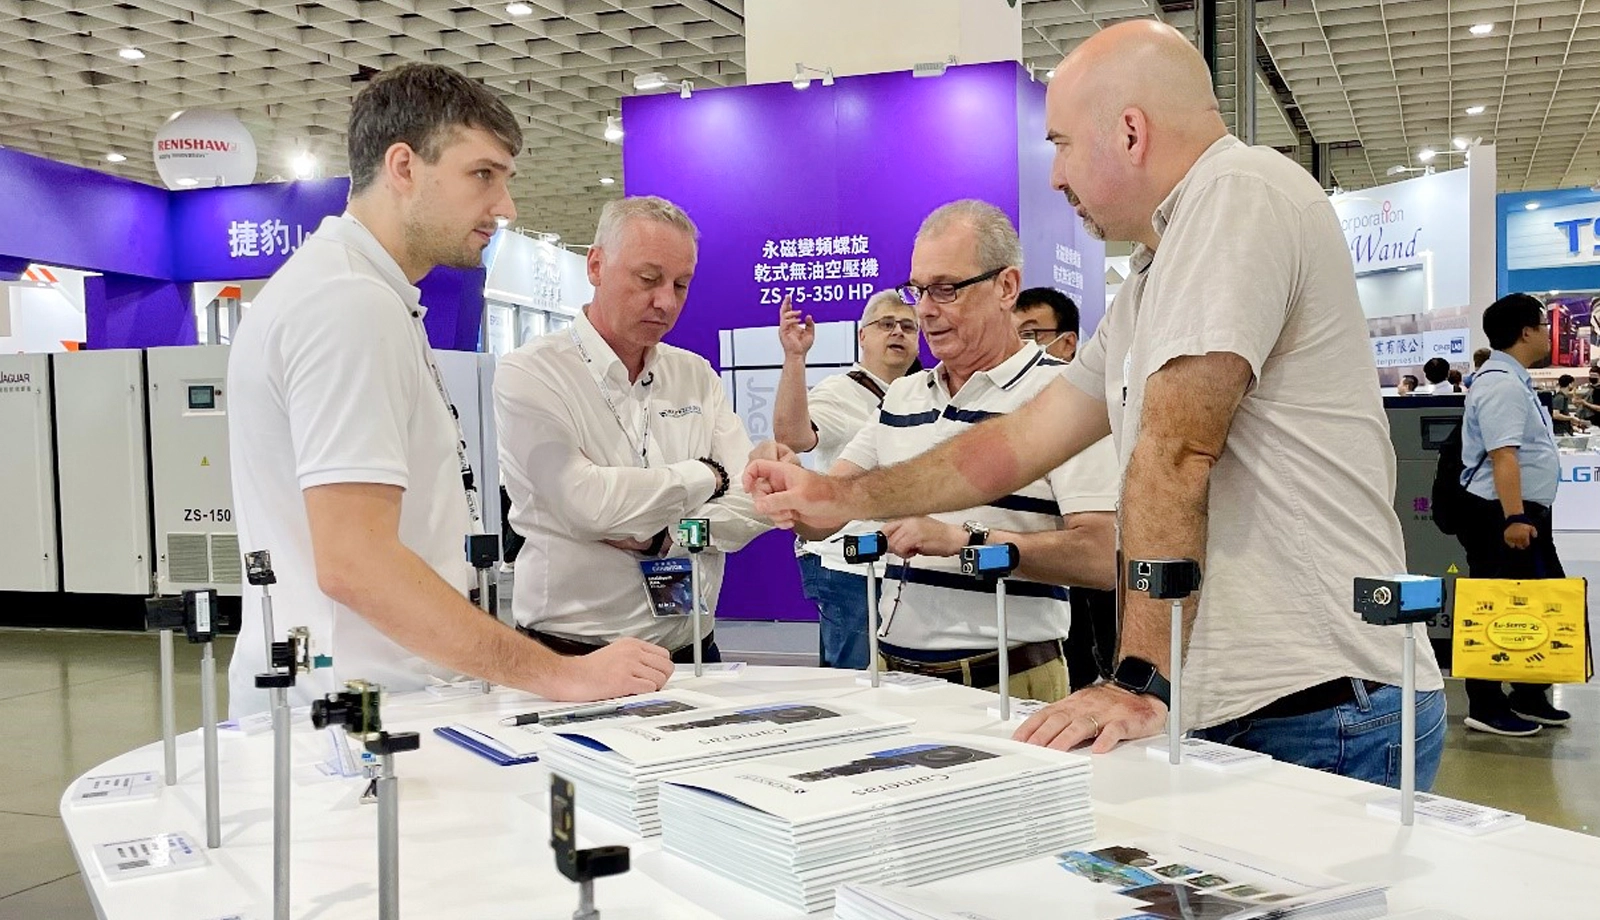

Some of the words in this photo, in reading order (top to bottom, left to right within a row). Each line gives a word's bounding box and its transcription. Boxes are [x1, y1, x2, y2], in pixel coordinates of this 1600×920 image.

[157, 138, 229, 152] RENISHAW
[762, 234, 870, 259] 永磁變頻螺旋
[1350, 226, 1423, 263] Wand
[1554, 217, 1600, 253] T
[754, 257, 880, 283] 乾式無油空壓機
[760, 286, 782, 304] ZS
[785, 283, 845, 303] 75-350
[848, 282, 874, 301] HP
[1375, 337, 1424, 356] 業有限公
[183, 508, 232, 522] ZS-150
[851, 773, 950, 796] Cameras
